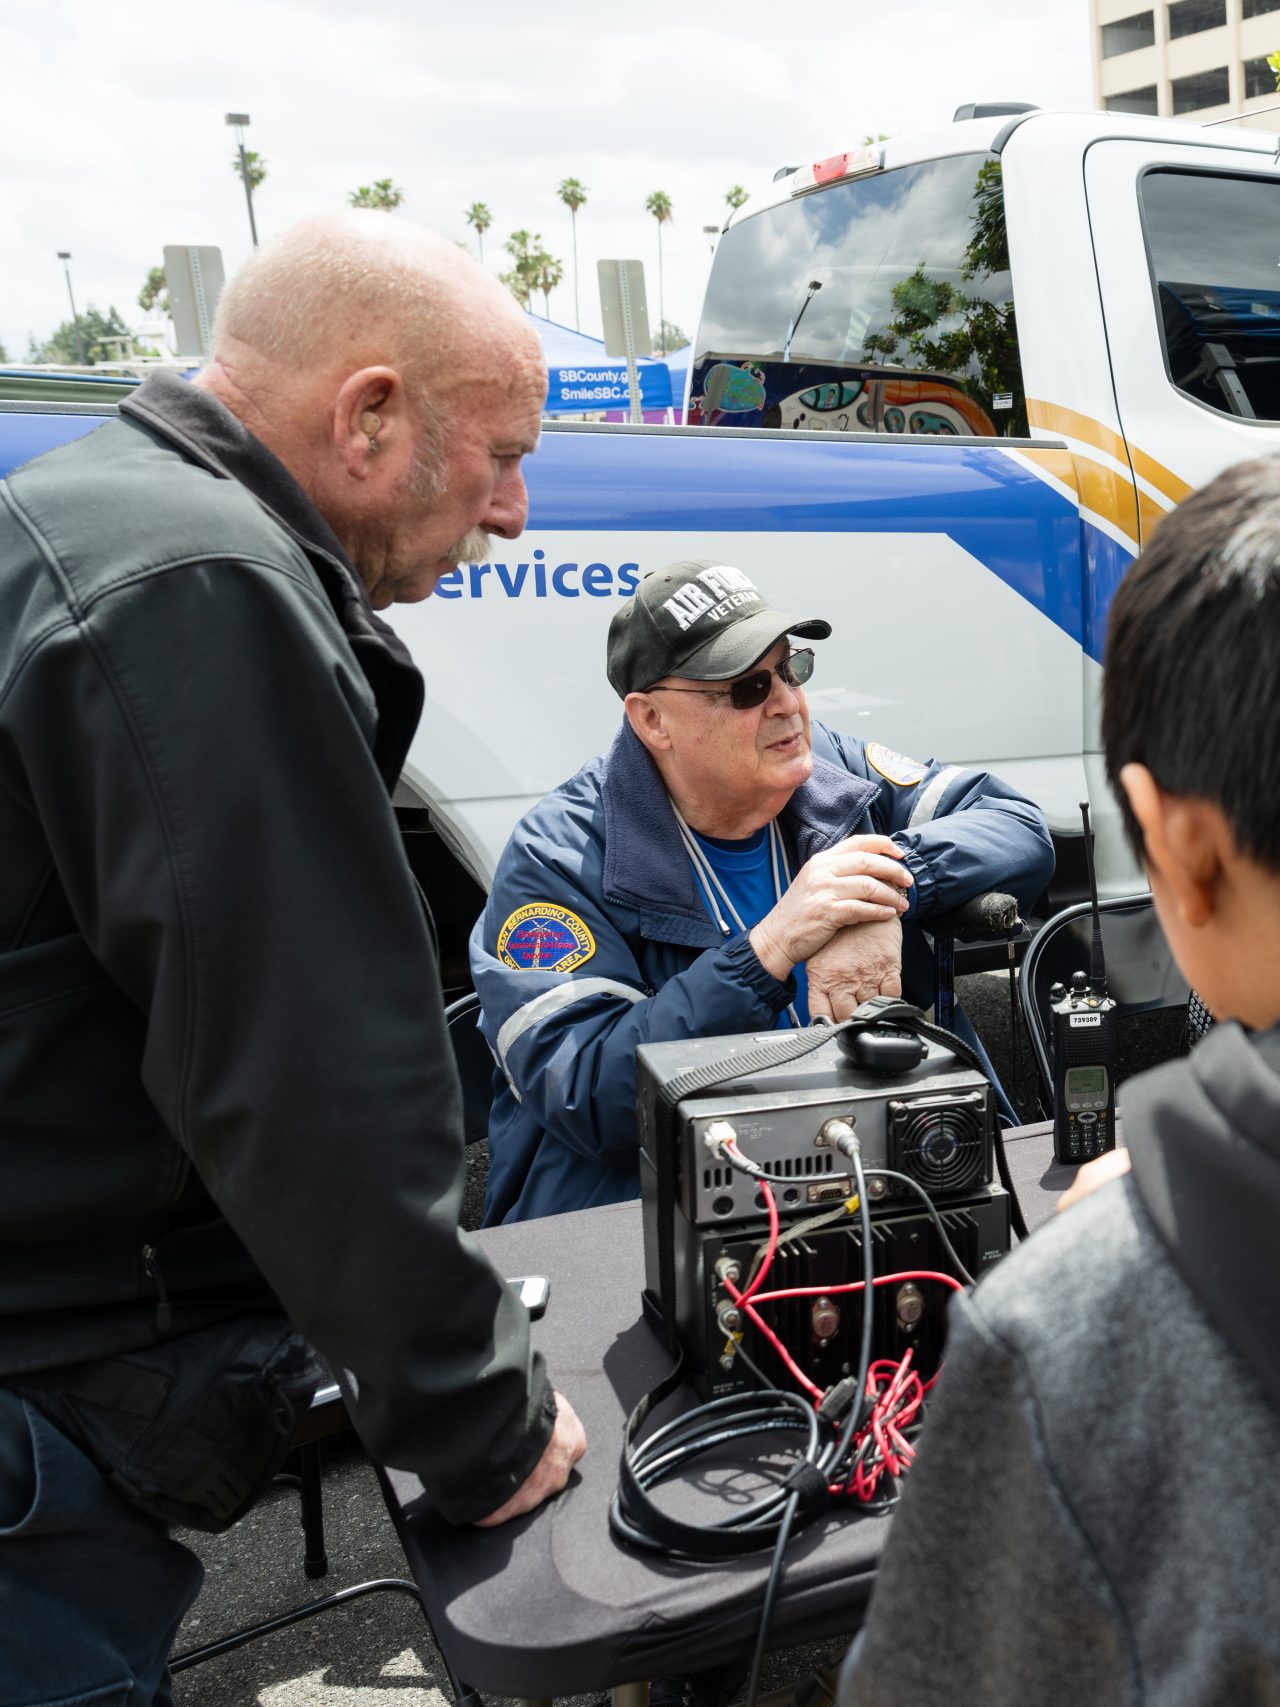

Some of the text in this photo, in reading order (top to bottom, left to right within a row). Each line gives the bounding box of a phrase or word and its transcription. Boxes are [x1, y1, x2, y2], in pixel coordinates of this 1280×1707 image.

[559, 370, 642, 383] SBCounty.g
[561, 387, 643, 401] SmileSBC.o
[662, 583, 717, 631] AIR
[707, 591, 761, 621] VETERAN
[500, 907, 591, 952] SAN BERNARDINO COUNTY
[504, 952, 583, 972] OPE AREA
